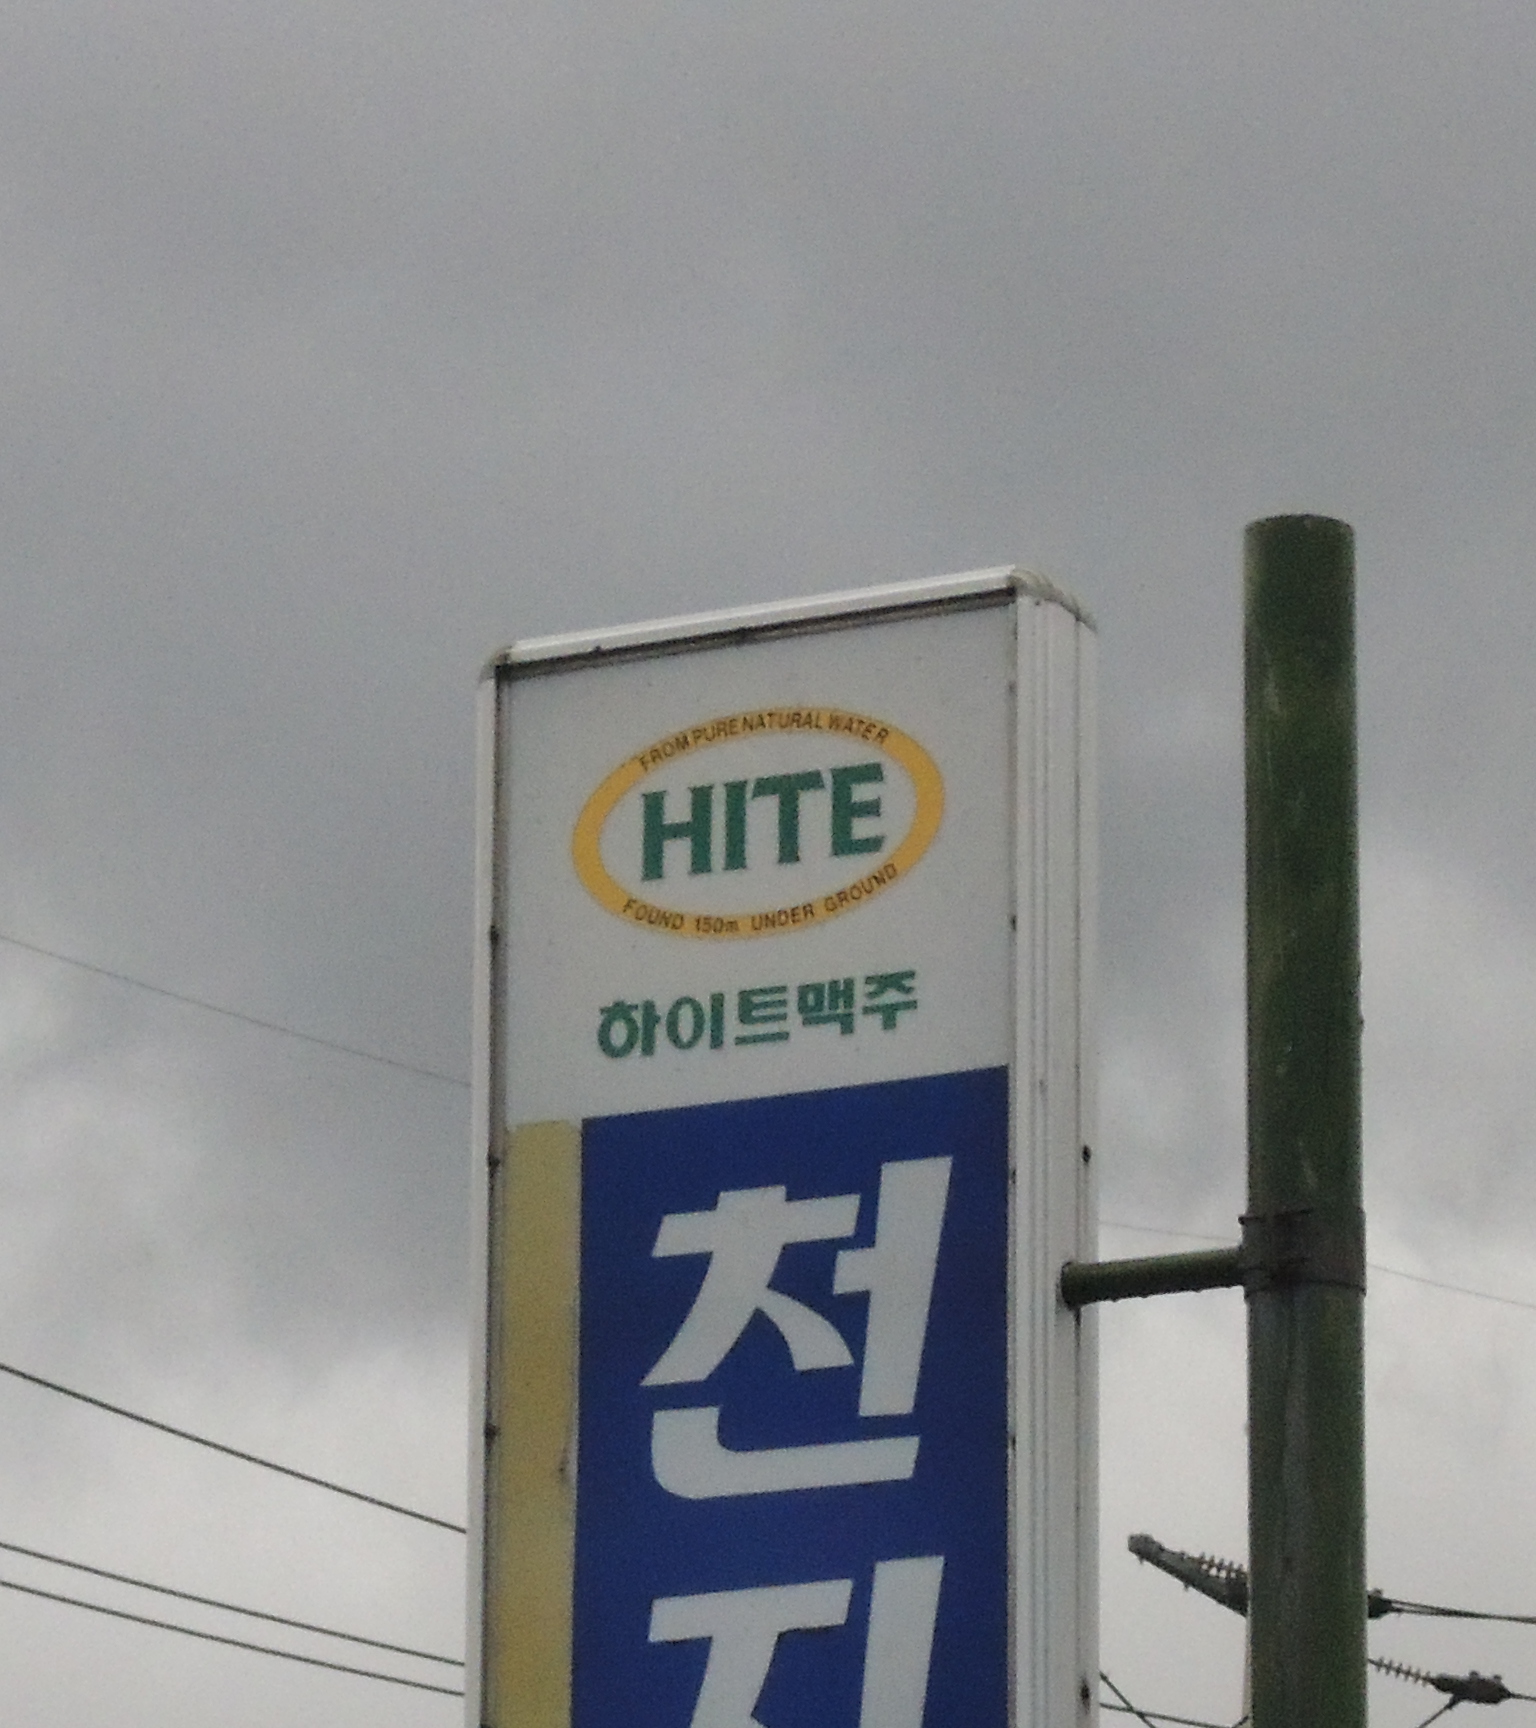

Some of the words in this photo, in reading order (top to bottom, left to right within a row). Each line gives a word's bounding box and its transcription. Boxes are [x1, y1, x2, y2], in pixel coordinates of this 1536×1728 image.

[638, 734, 691, 772] FROM
[692, 719, 740, 745] PURE
[740, 710, 824, 732] NATURAL
[827, 713, 891, 745] WATER
[640, 762, 887, 882] HITE
[622, 898, 685, 931] FOUND
[750, 904, 816, 930] UNDER
[824, 863, 898, 913] GROUND
[596, 969, 919, 1060] 하이트맥주
